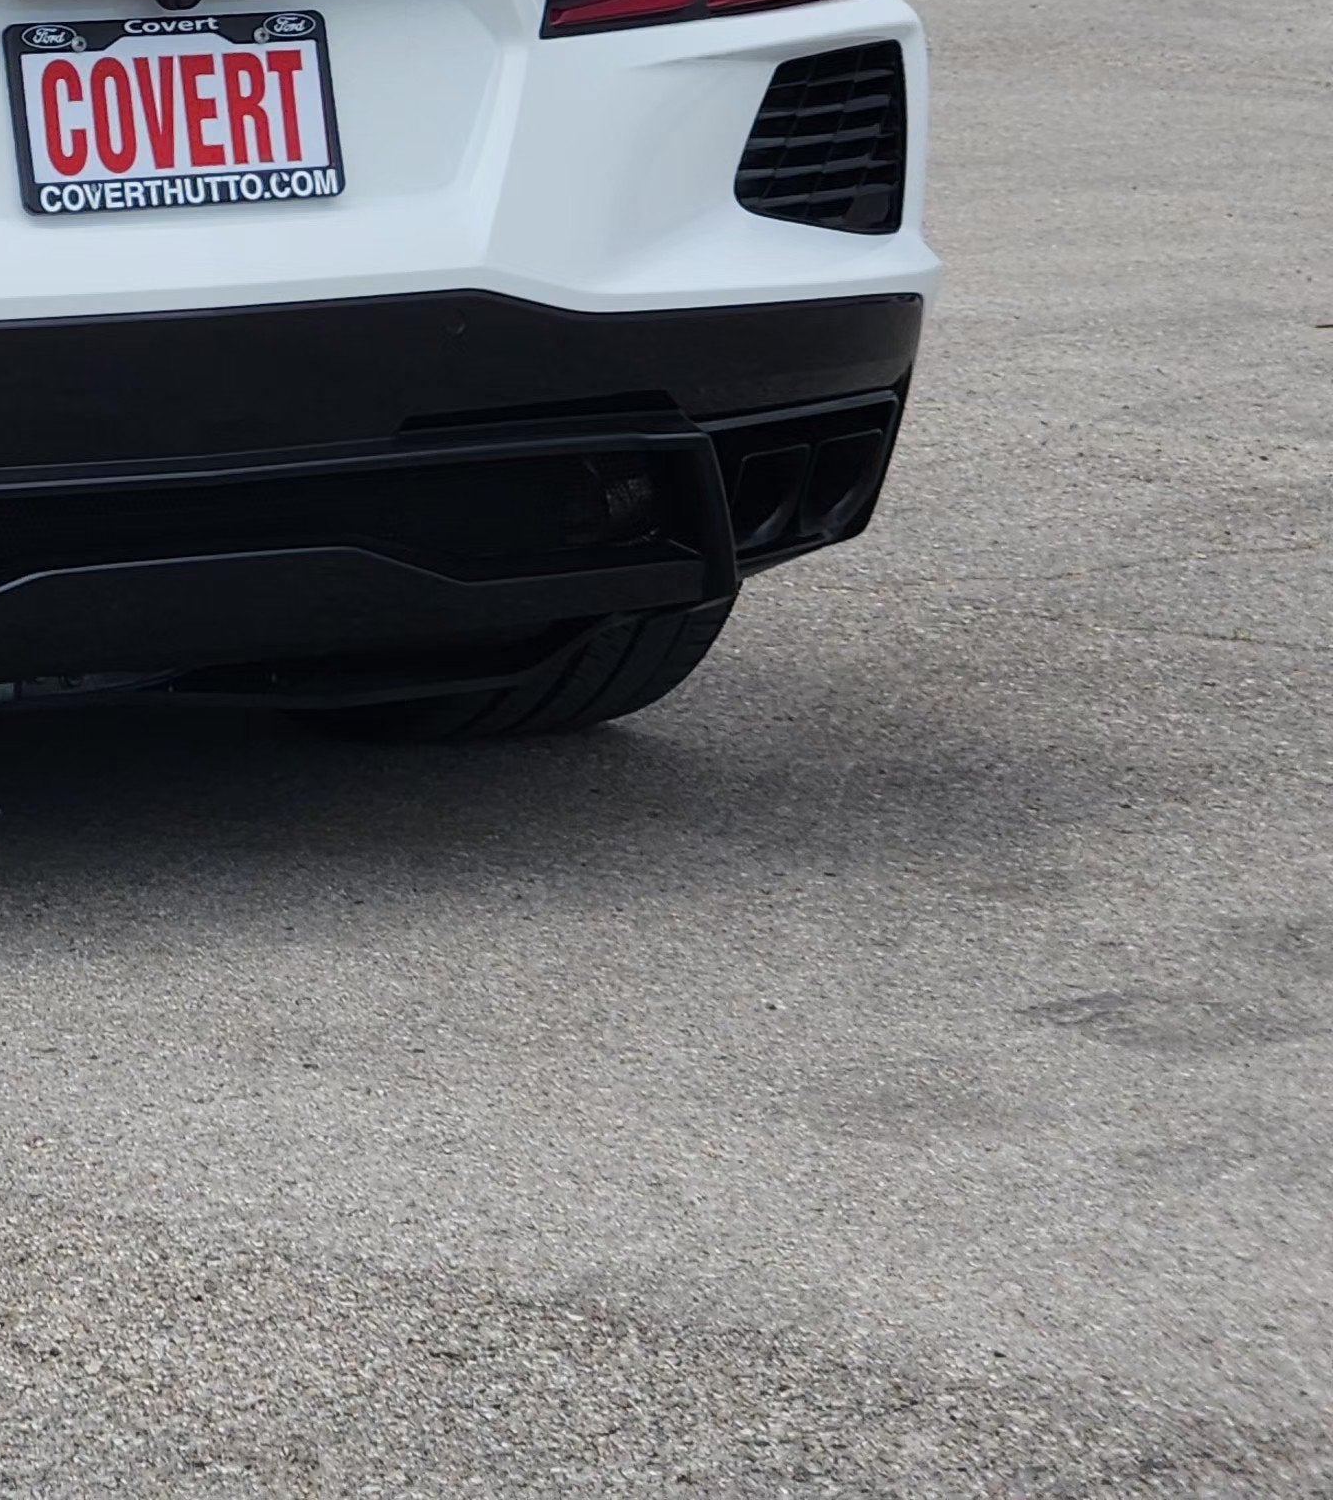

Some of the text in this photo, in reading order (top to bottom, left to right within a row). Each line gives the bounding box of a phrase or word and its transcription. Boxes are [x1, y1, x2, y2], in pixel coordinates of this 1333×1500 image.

[123, 16, 220, 35] Covert
[41, 49, 303, 177] COVERT
[39, 168, 339, 213] COVERTHUTTO.COM
